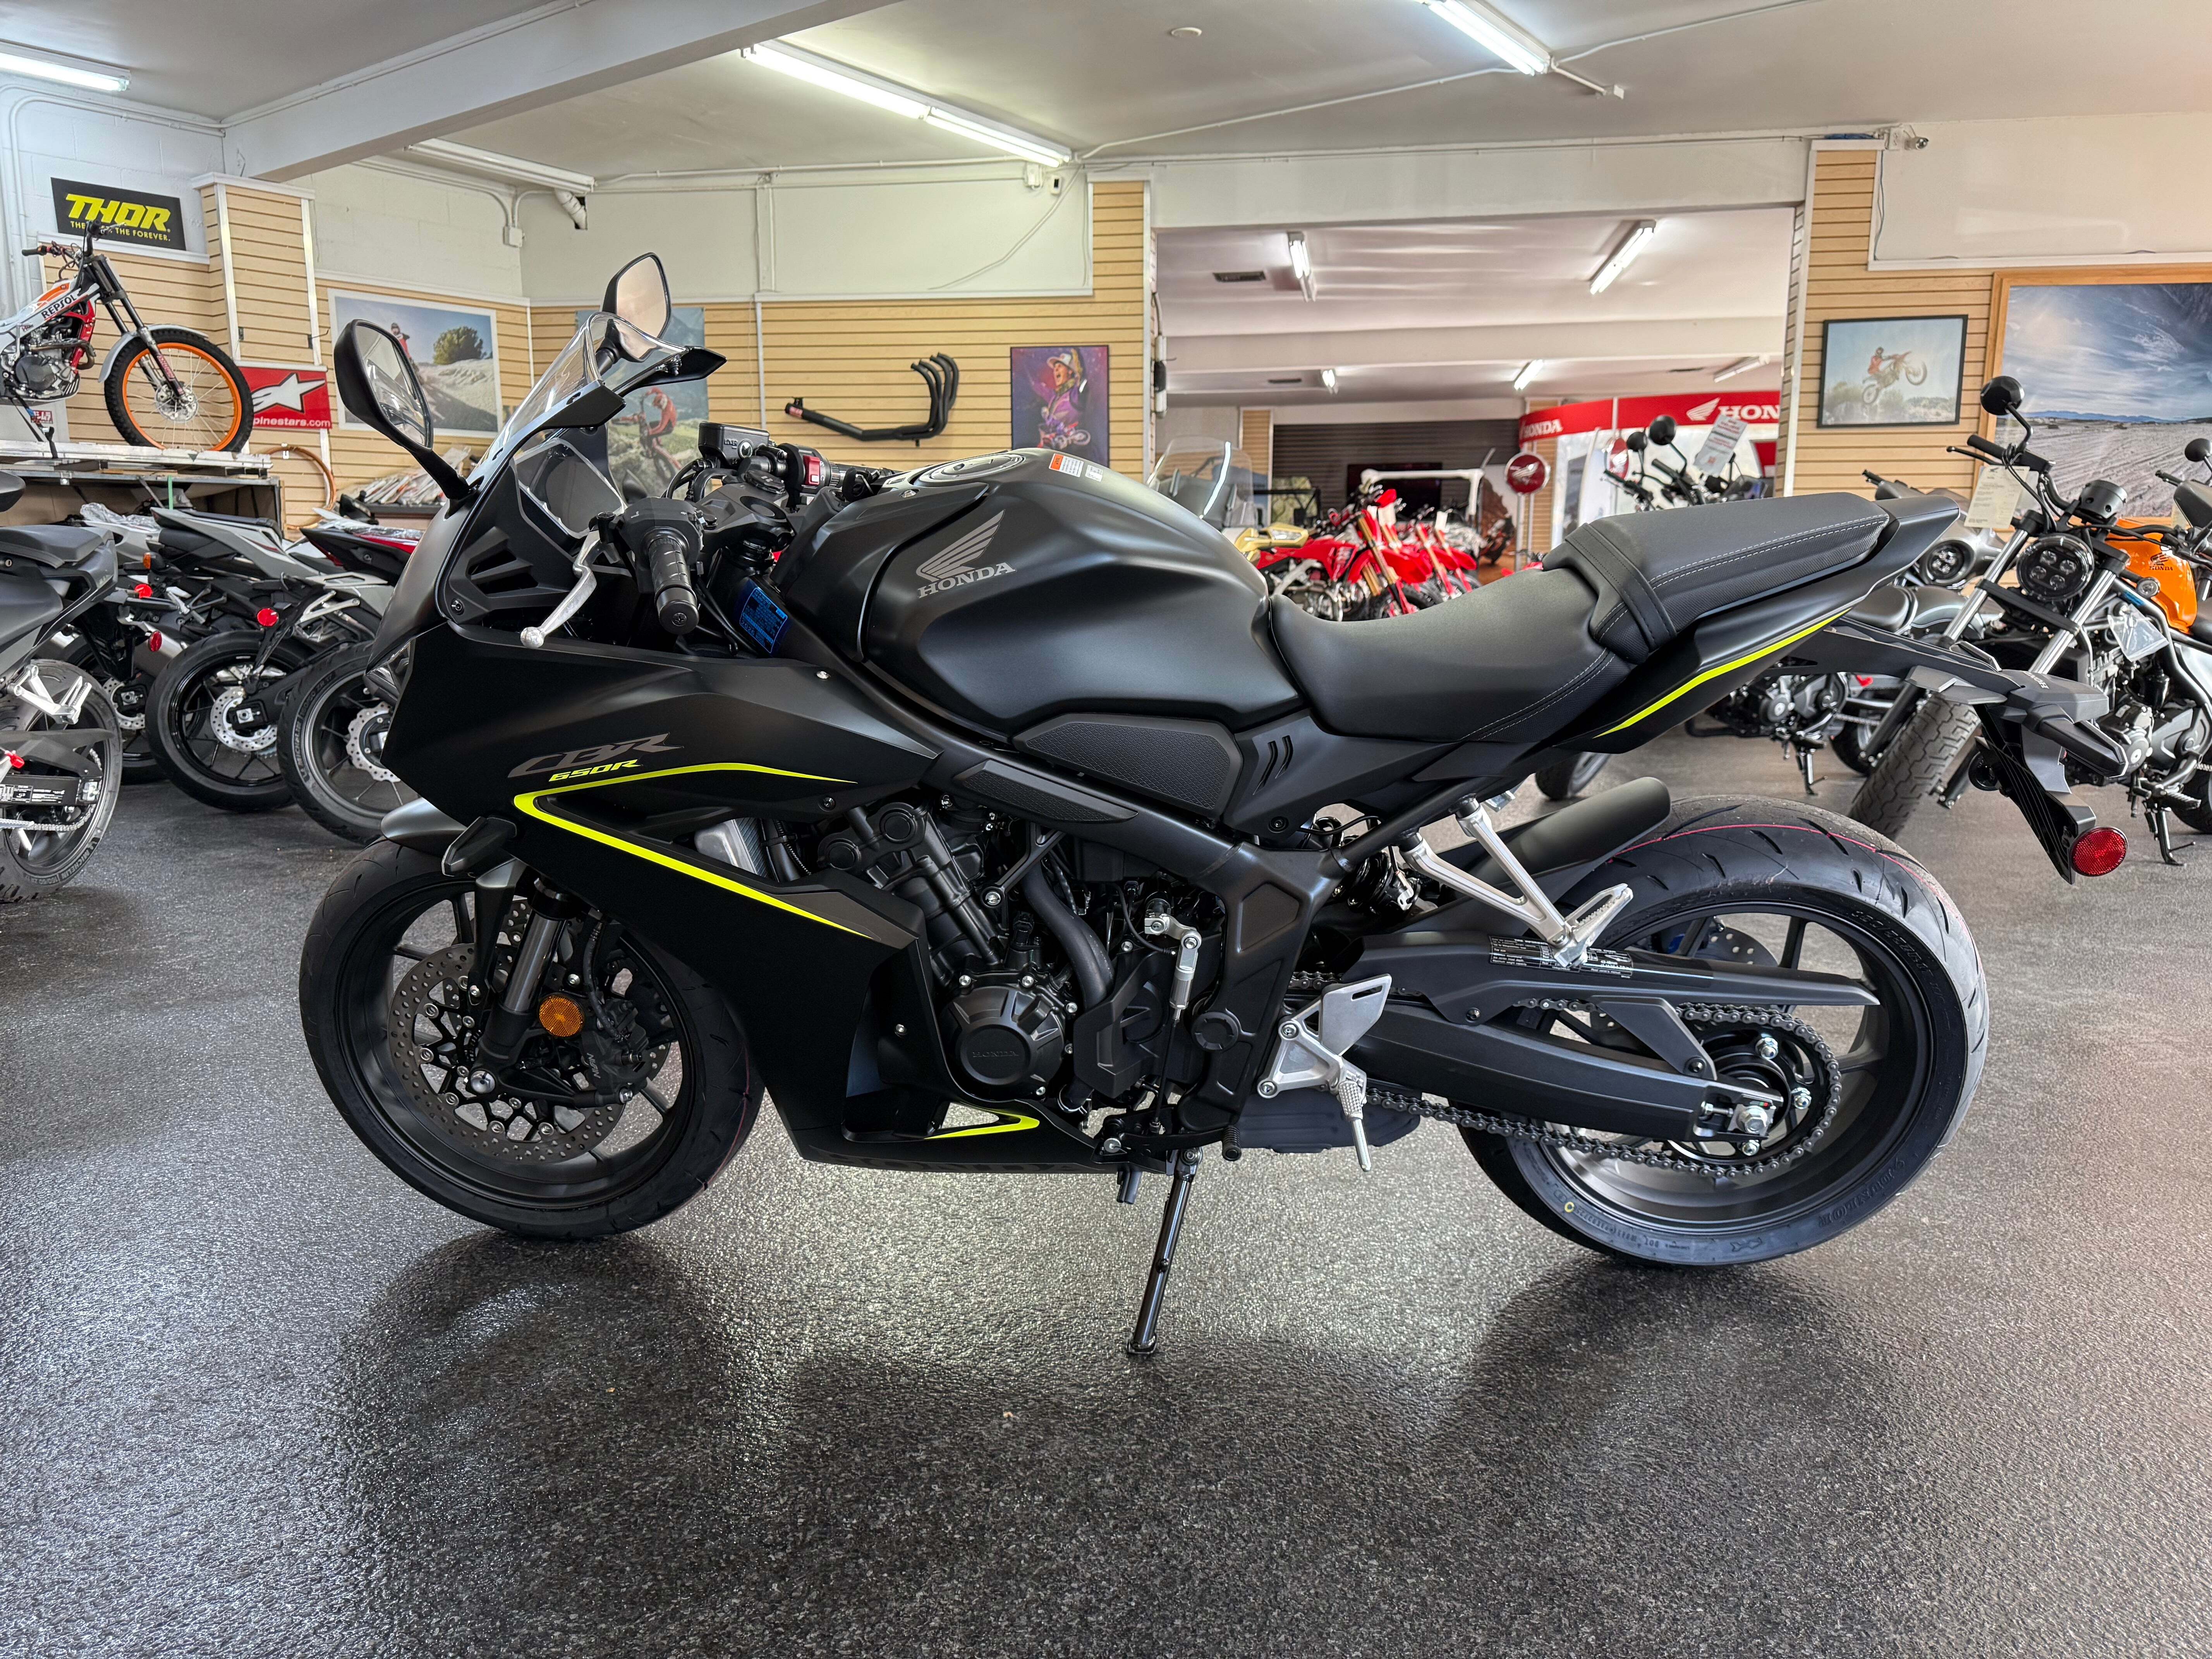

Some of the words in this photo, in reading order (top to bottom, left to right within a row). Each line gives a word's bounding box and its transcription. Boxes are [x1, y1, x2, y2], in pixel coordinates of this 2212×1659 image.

[65, 194, 171, 232] THOR
[116, 227, 130, 235] THE
[133, 230, 170, 241] FOREVER.
[41, 295, 77, 319] REPSOL
[917, 562, 1016, 598] HONDA
[508, 733, 684, 778] CBR
[548, 759, 643, 782] 650R
[62, 849, 90, 878] MICHELIN
